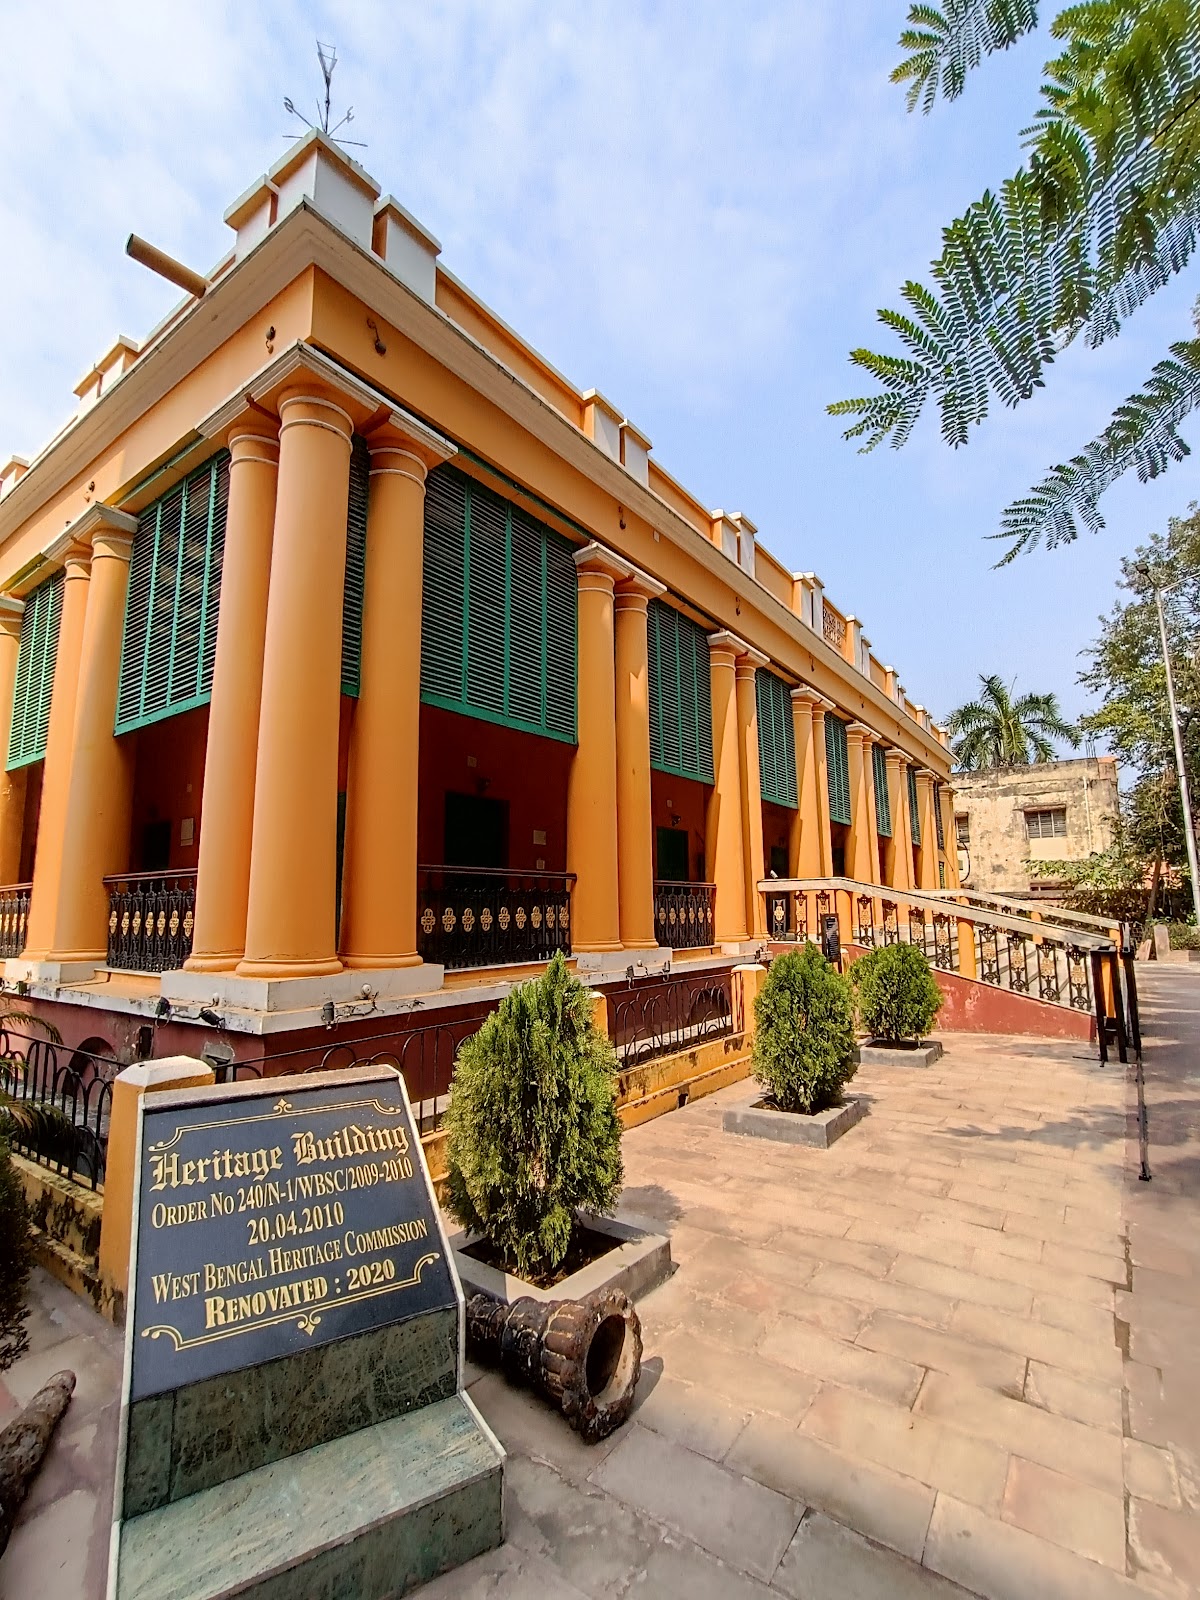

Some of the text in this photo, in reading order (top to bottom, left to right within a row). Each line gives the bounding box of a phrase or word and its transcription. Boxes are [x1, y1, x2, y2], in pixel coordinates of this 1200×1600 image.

[148, 1124, 410, 1193] Heritage Building
[151, 1156, 413, 1229] ORDER No 240/N-1/WBSC/2009-2010
[247, 1201, 344, 1246] 20.04.2010
[151, 1218, 428, 1305] WEST BENGAL HERITAGE COMMISSION
[204, 1276, 328, 1330] RENOVATED
[346, 1258, 396, 1291] 2020
